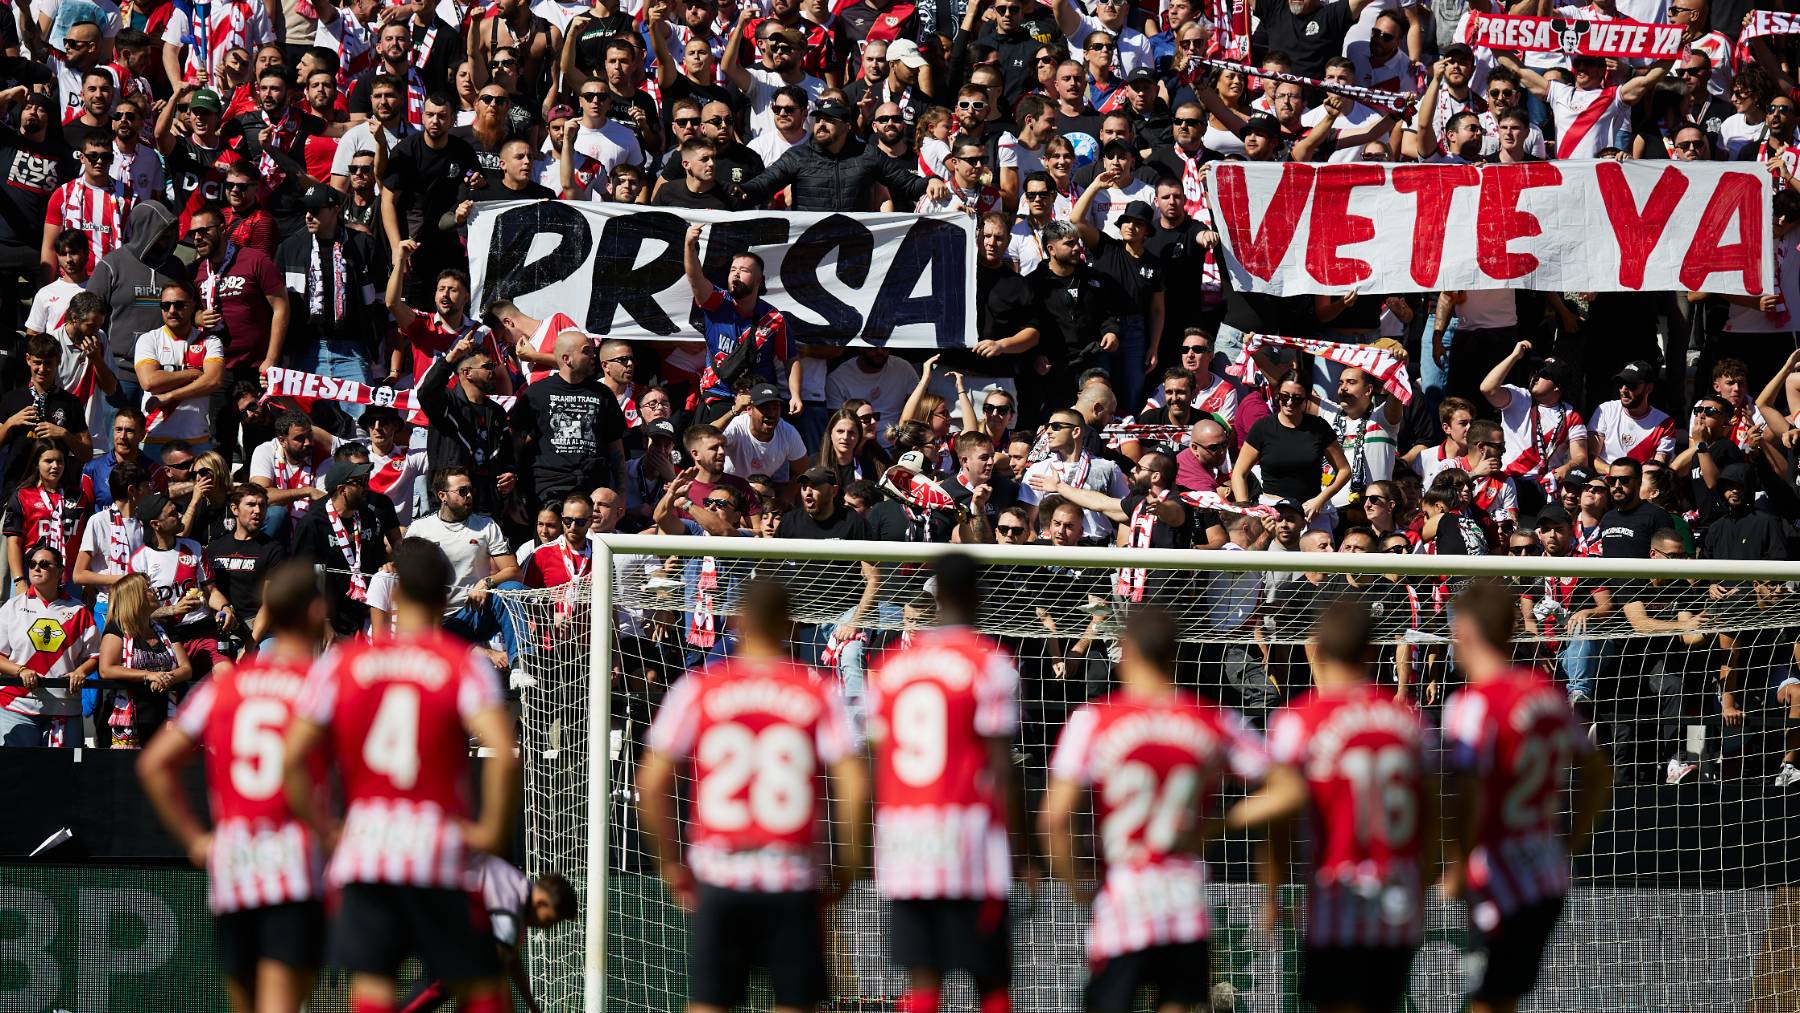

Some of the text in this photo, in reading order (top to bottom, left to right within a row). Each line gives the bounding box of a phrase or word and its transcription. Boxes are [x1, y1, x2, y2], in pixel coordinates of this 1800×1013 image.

[1477, 17, 1683, 55] PRESA VETE YA
[8, 165, 58, 192] NZS
[13, 150, 58, 176] FCK
[1215, 161, 1763, 295] VETE YA
[266, 366, 360, 402] PRESA
[230, 697, 288, 801] 5
[362, 681, 421, 791] 4
[698, 720, 815, 835] 28
[891, 680, 947, 788] 9
[1340, 744, 1418, 847] 16
